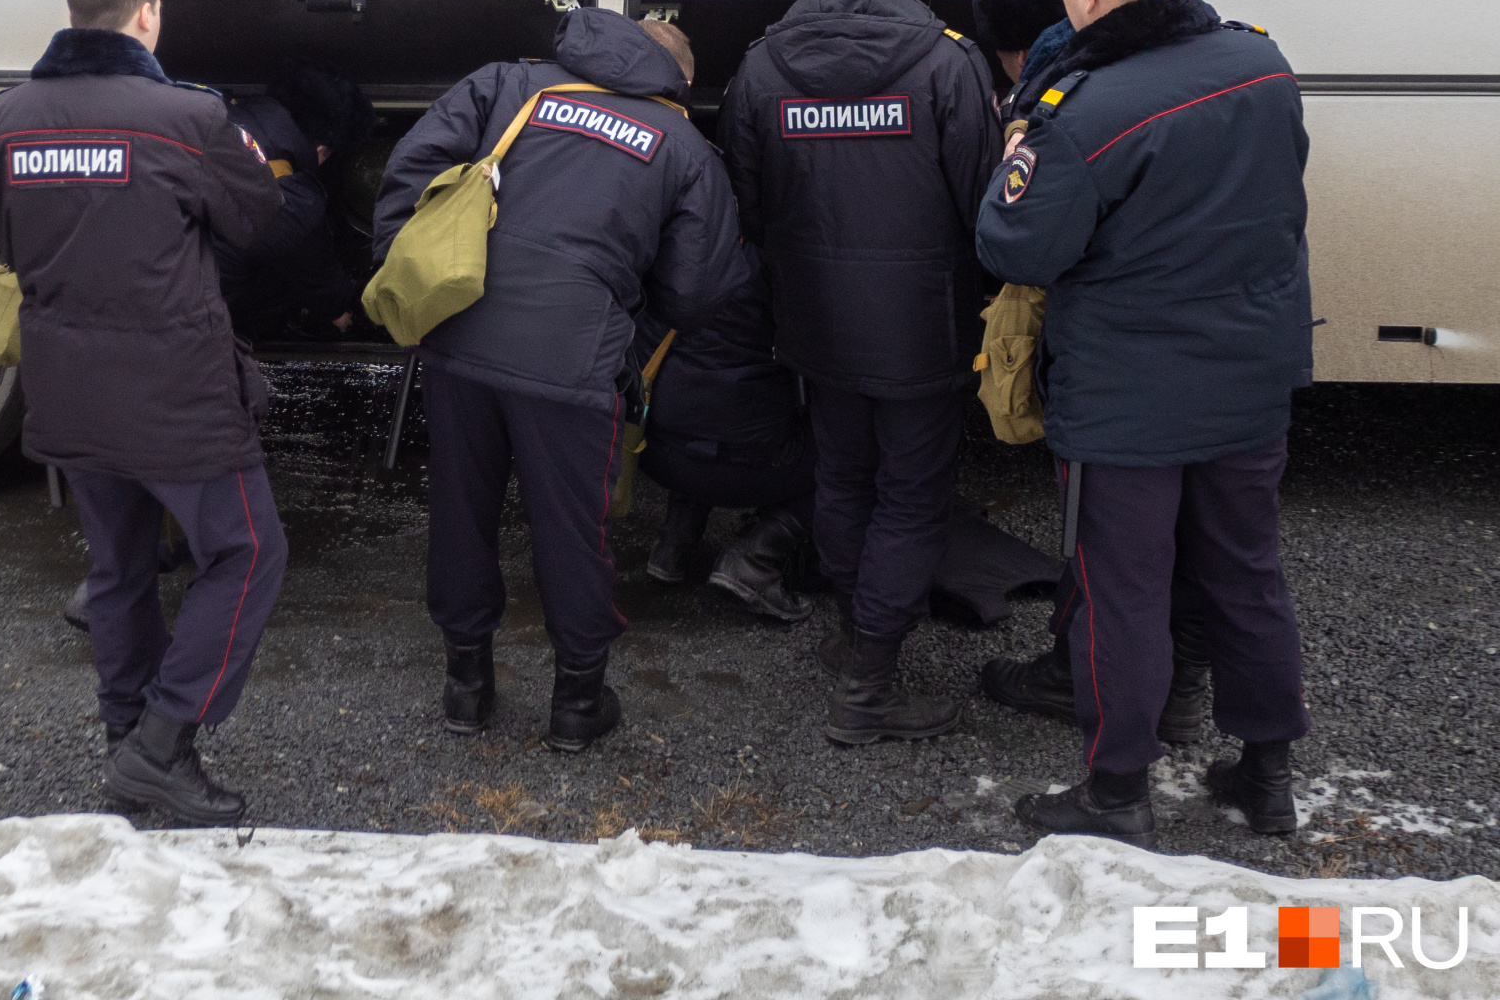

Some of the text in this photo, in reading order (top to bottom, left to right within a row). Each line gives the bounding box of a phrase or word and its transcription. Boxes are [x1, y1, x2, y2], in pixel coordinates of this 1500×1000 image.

[538, 100, 654, 151] ПОЛИЦИЯ
[787, 103, 903, 130] ПОЛИЦИЯ
[13, 148, 123, 176] ПОЛИЦИЯ
